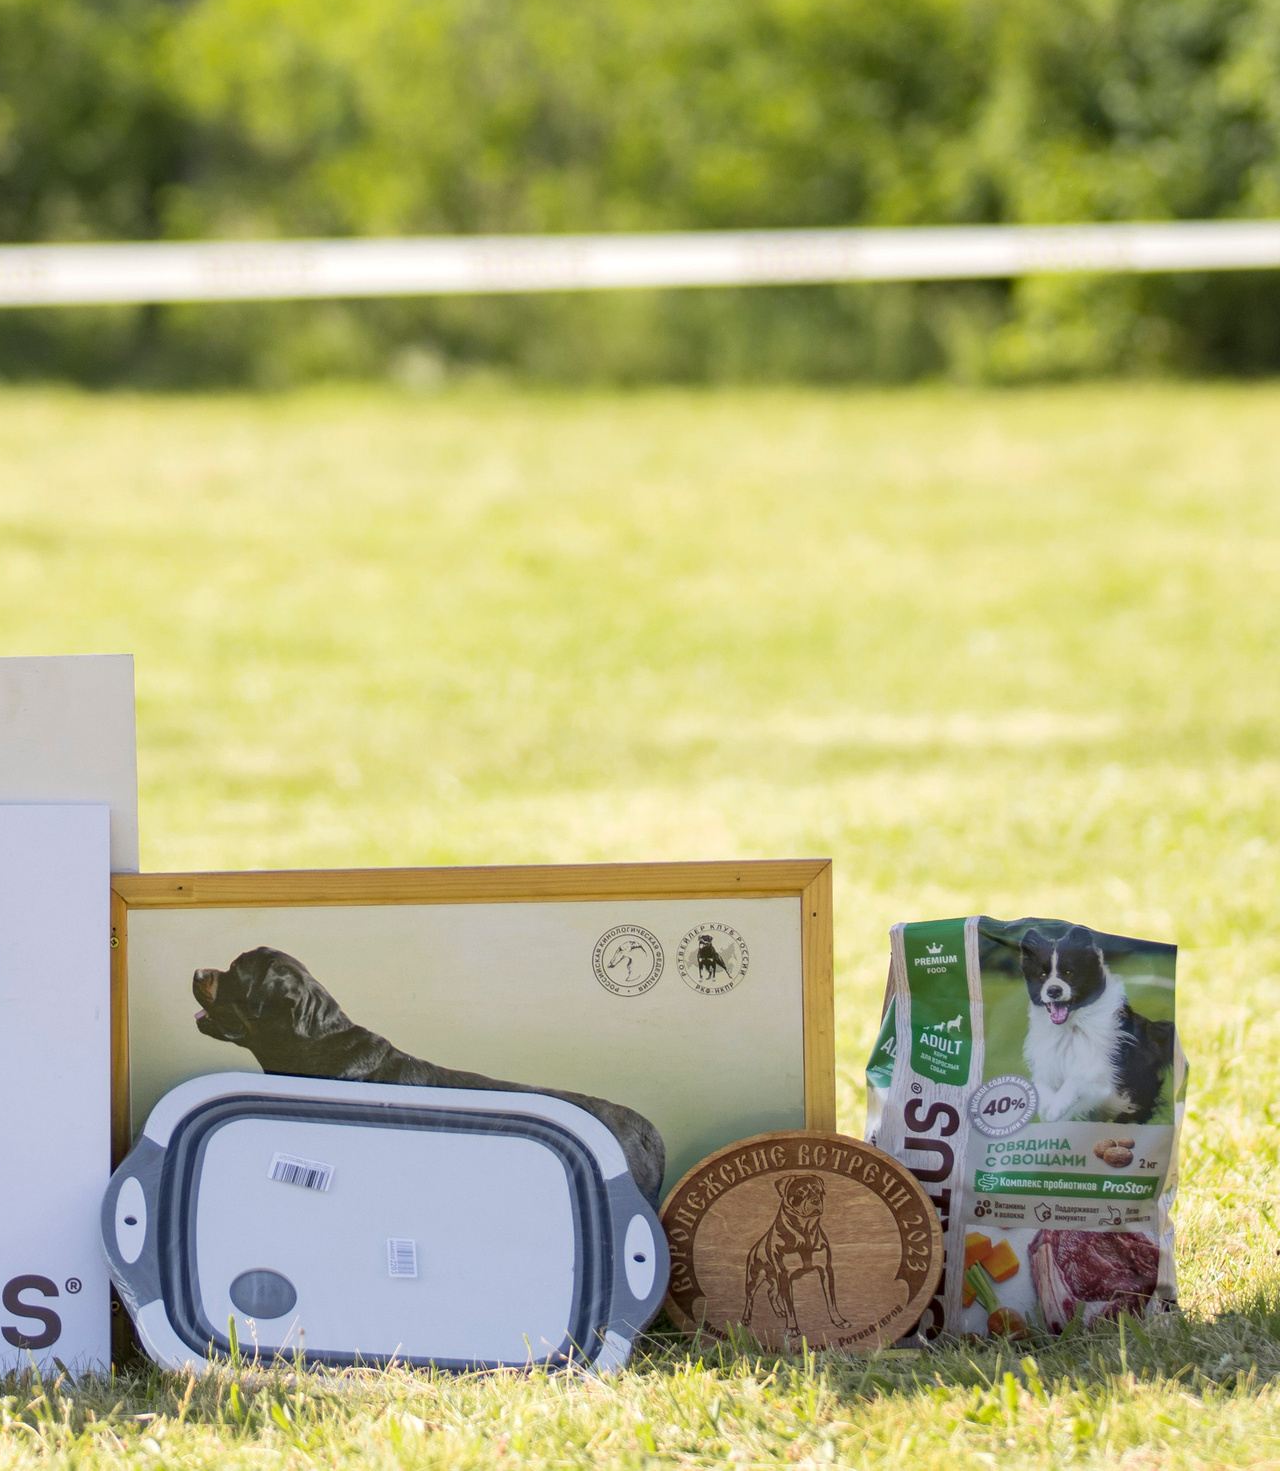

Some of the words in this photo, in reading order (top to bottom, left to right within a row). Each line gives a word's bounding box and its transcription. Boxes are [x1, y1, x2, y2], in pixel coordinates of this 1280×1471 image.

[599, 926, 660, 950] КИНОЛОГИЧЕСКАЯ
[678, 925, 705, 977] РОТВЕЙЛЕР
[709, 924, 735, 936] КЛУБ
[736, 936, 749, 976] РОССИИ
[914, 955, 958, 966] PREMIUM
[594, 948, 620, 993] РОССИЙСКАЯ
[637, 950, 663, 992] ФЕДЕРАЦИЯ
[926, 966, 947, 974] FOOD
[919, 1032, 963, 1055] ADULT
[988, 1076, 1032, 1090] СОДЕРЖАНИЕ
[982, 1096, 1026, 1116] 40%
[986, 1138, 1071, 1154] ГОВЯДИНА
[985, 1157, 997, 1167] С
[1000, 1153, 1086, 1167] ОВОЩАМИ
[1139, 1158, 1145, 1168] 2
[1146, 1160, 1158, 1170] кг
[1000, 1176, 1042, 1189] Комплекс
[1043, 1178, 1097, 1192] пробиотиков
[994, 1200, 1026, 1210] Витамины
[669, 1144, 787, 1293] ВОРОНЕЖСКИЕ
[796, 1143, 913, 1211] ВСТРЕЧИ
[901, 1214, 928, 1272] 2023
